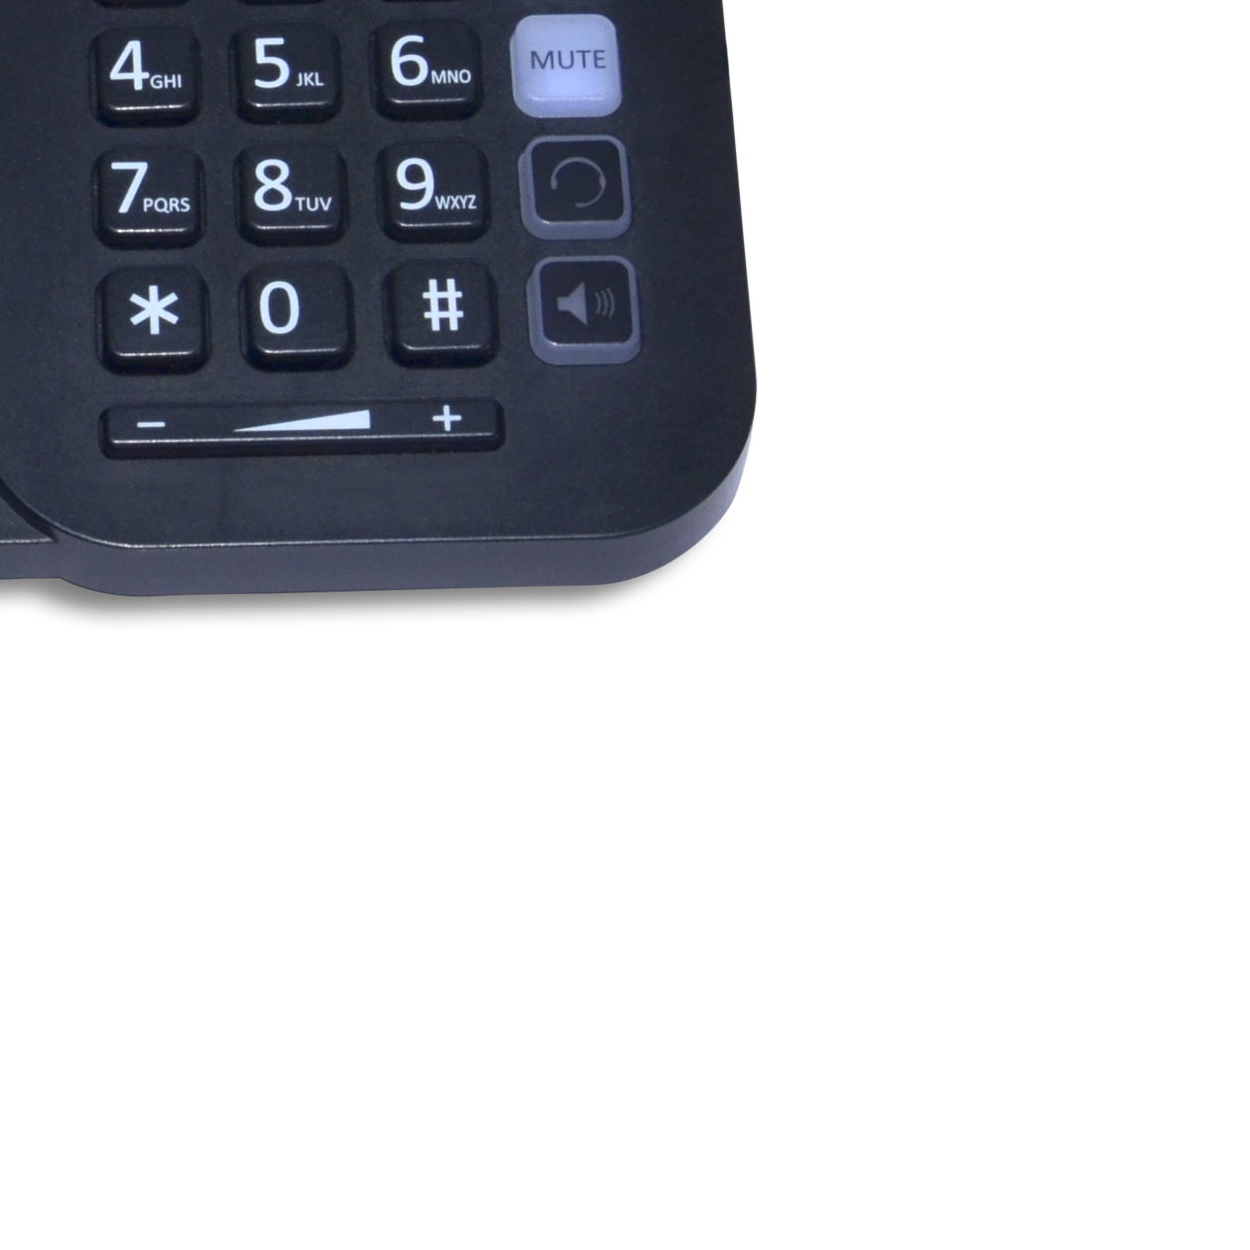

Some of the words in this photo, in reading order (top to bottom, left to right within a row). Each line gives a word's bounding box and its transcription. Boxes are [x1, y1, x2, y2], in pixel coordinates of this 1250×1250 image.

[110, 40, 150, 90] 4
[150, 75, 181, 89] GHI
[255, 38, 289, 88] 5
[297, 72, 324, 86] JKL
[391, 35, 428, 86] 6
[431, 69, 471, 83] MNO
[530, 50, 606, 69] MUTE
[111, 162, 148, 213] 7
[143, 198, 190, 213] PQRS
[254, 159, 292, 211] 8
[295, 197, 332, 211] TUV
[396, 158, 434, 210] 9
[435, 195, 476, 209] WXYZ
[260, 281, 299, 334] 0
